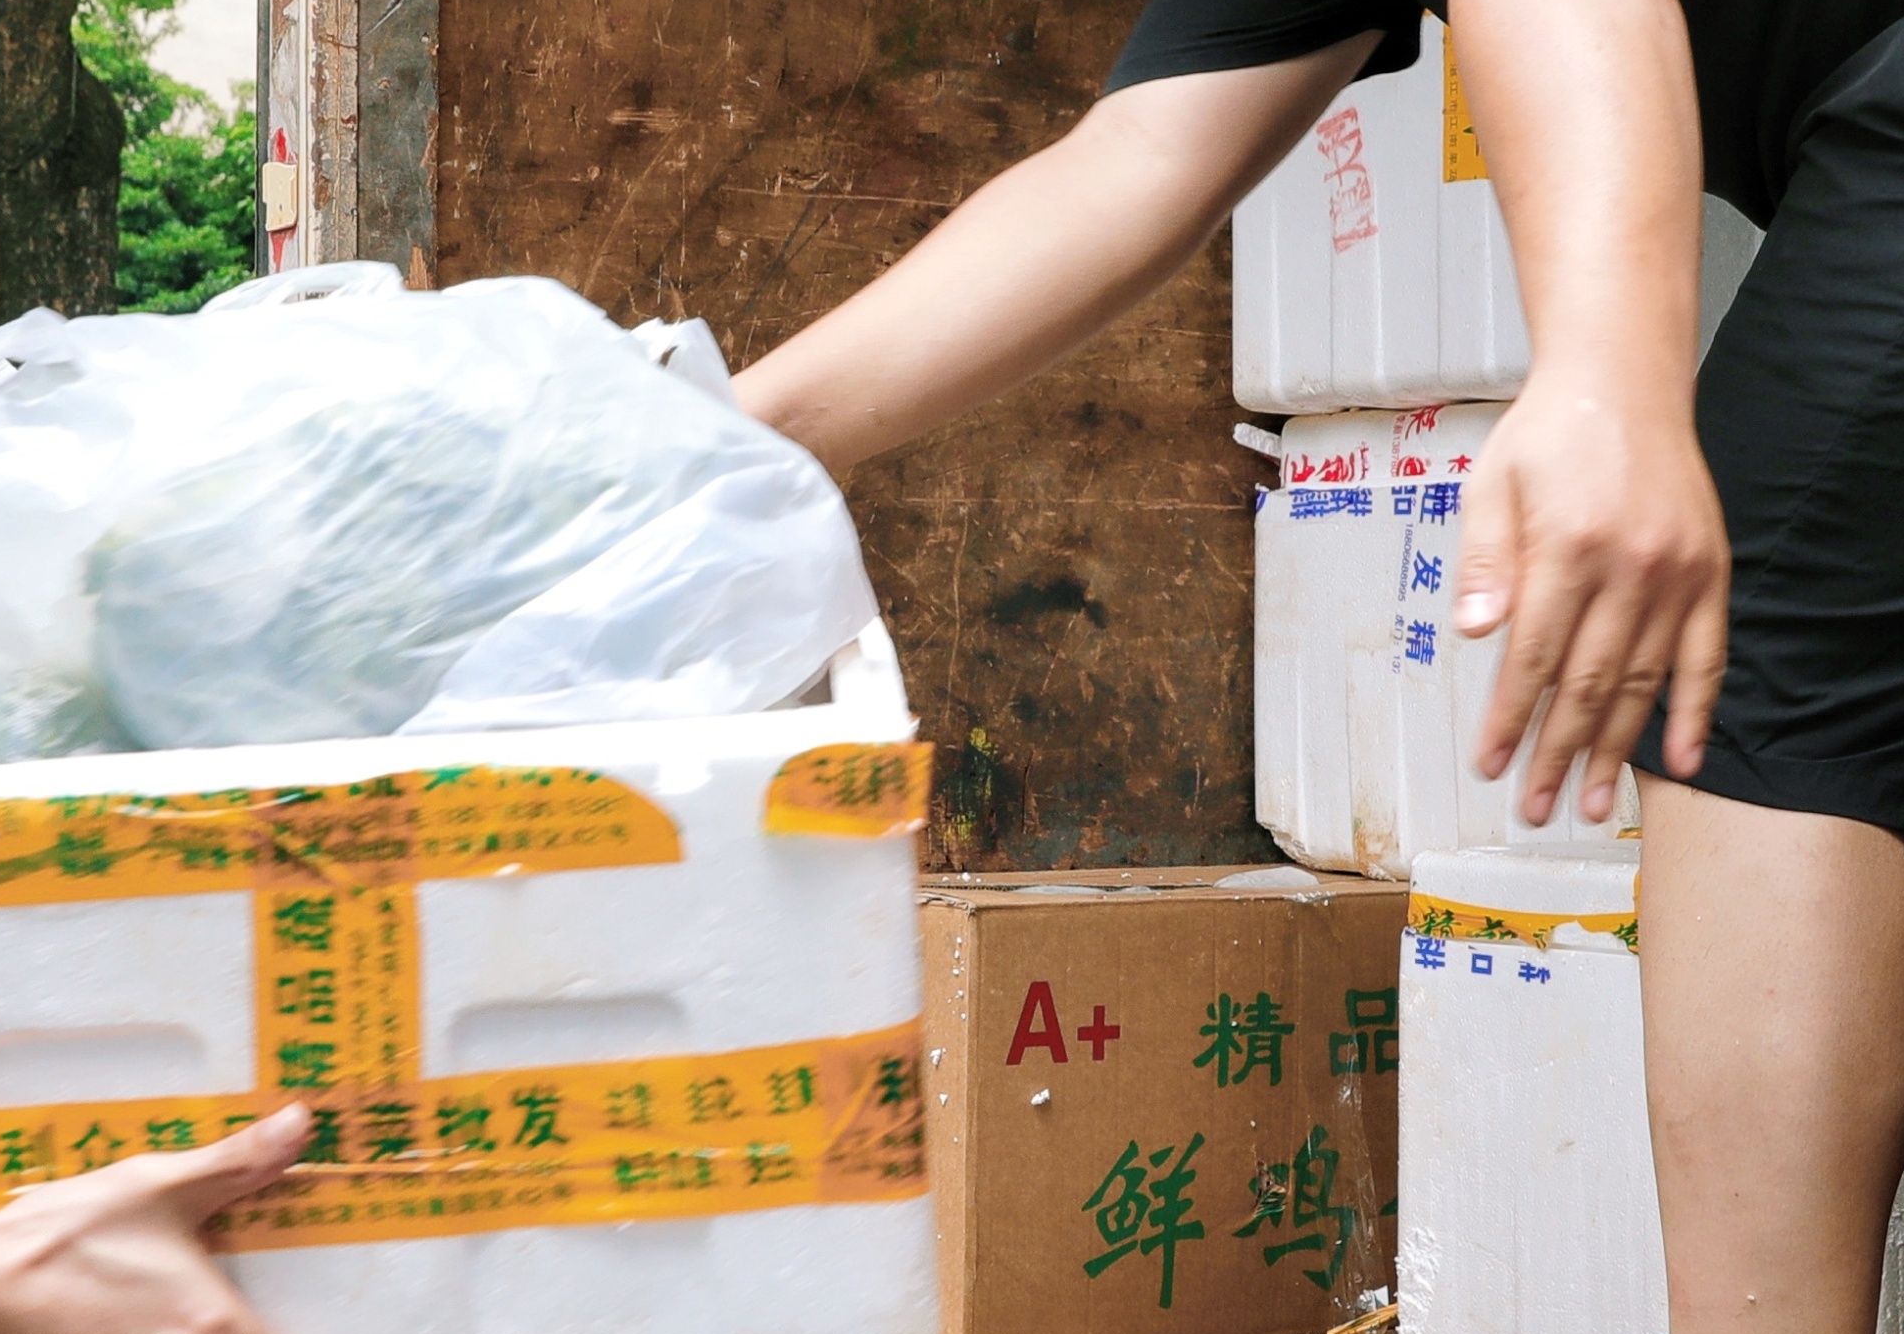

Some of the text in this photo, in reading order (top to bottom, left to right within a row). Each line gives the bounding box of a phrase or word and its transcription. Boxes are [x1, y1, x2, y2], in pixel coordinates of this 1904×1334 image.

[1005, 980, 1399, 1088] A+ 精品
[1081, 1132, 1398, 1309] 鲜鸡
